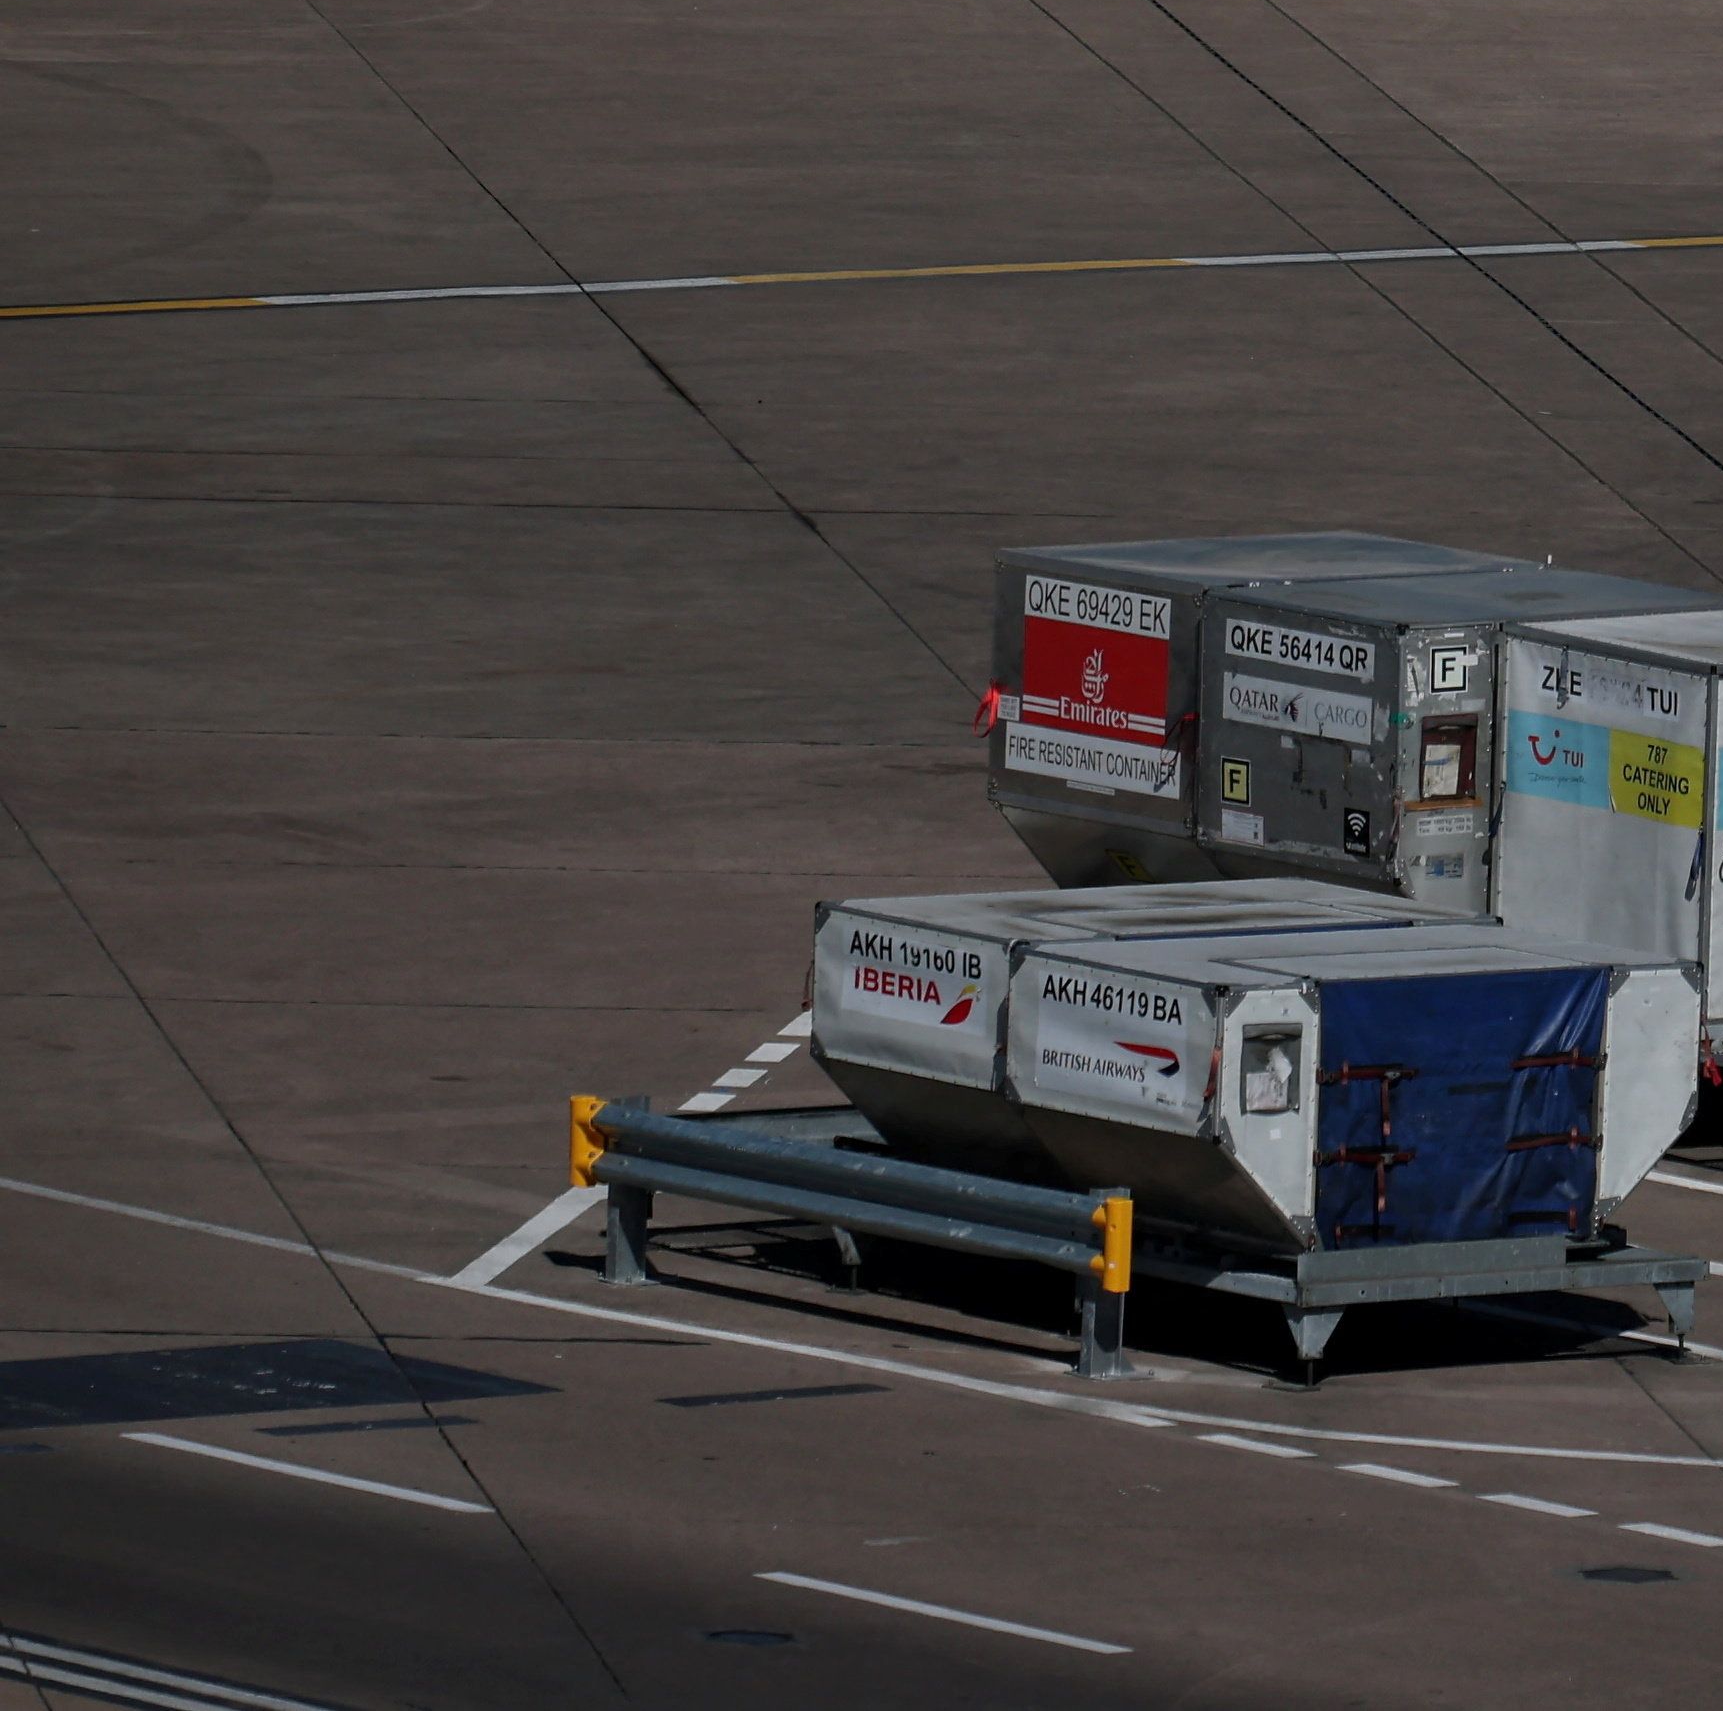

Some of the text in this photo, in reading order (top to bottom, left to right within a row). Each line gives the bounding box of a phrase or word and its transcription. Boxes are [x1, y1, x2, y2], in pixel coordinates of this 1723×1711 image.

[1028, 580, 1167, 635] QKE 69429 EK
[1231, 624, 1368, 673] QKE 56414 QR
[1441, 657, 1457, 683] F
[1060, 696, 1128, 730] Emirates
[1229, 686, 1368, 728] QATAR CARGO
[1646, 686, 1678, 717] TUI
[1008, 735, 1176, 787] FIRE RESISTANT CONTAINER
[1562, 749, 1584, 769] TUI
[1647, 744, 1668, 766] 787
[1228, 769, 1242, 794] F
[1623, 764, 1689, 795] CATERING
[1637, 792, 1671, 816] ONLY
[850, 930, 893, 962] AKH
[962, 951, 983, 980] IB
[854, 966, 942, 1006] IBERIA
[1043, 975, 1182, 1025] AKH 46119 BA
[1042, 1049, 1146, 1084] BRITISH AIRWAYS
